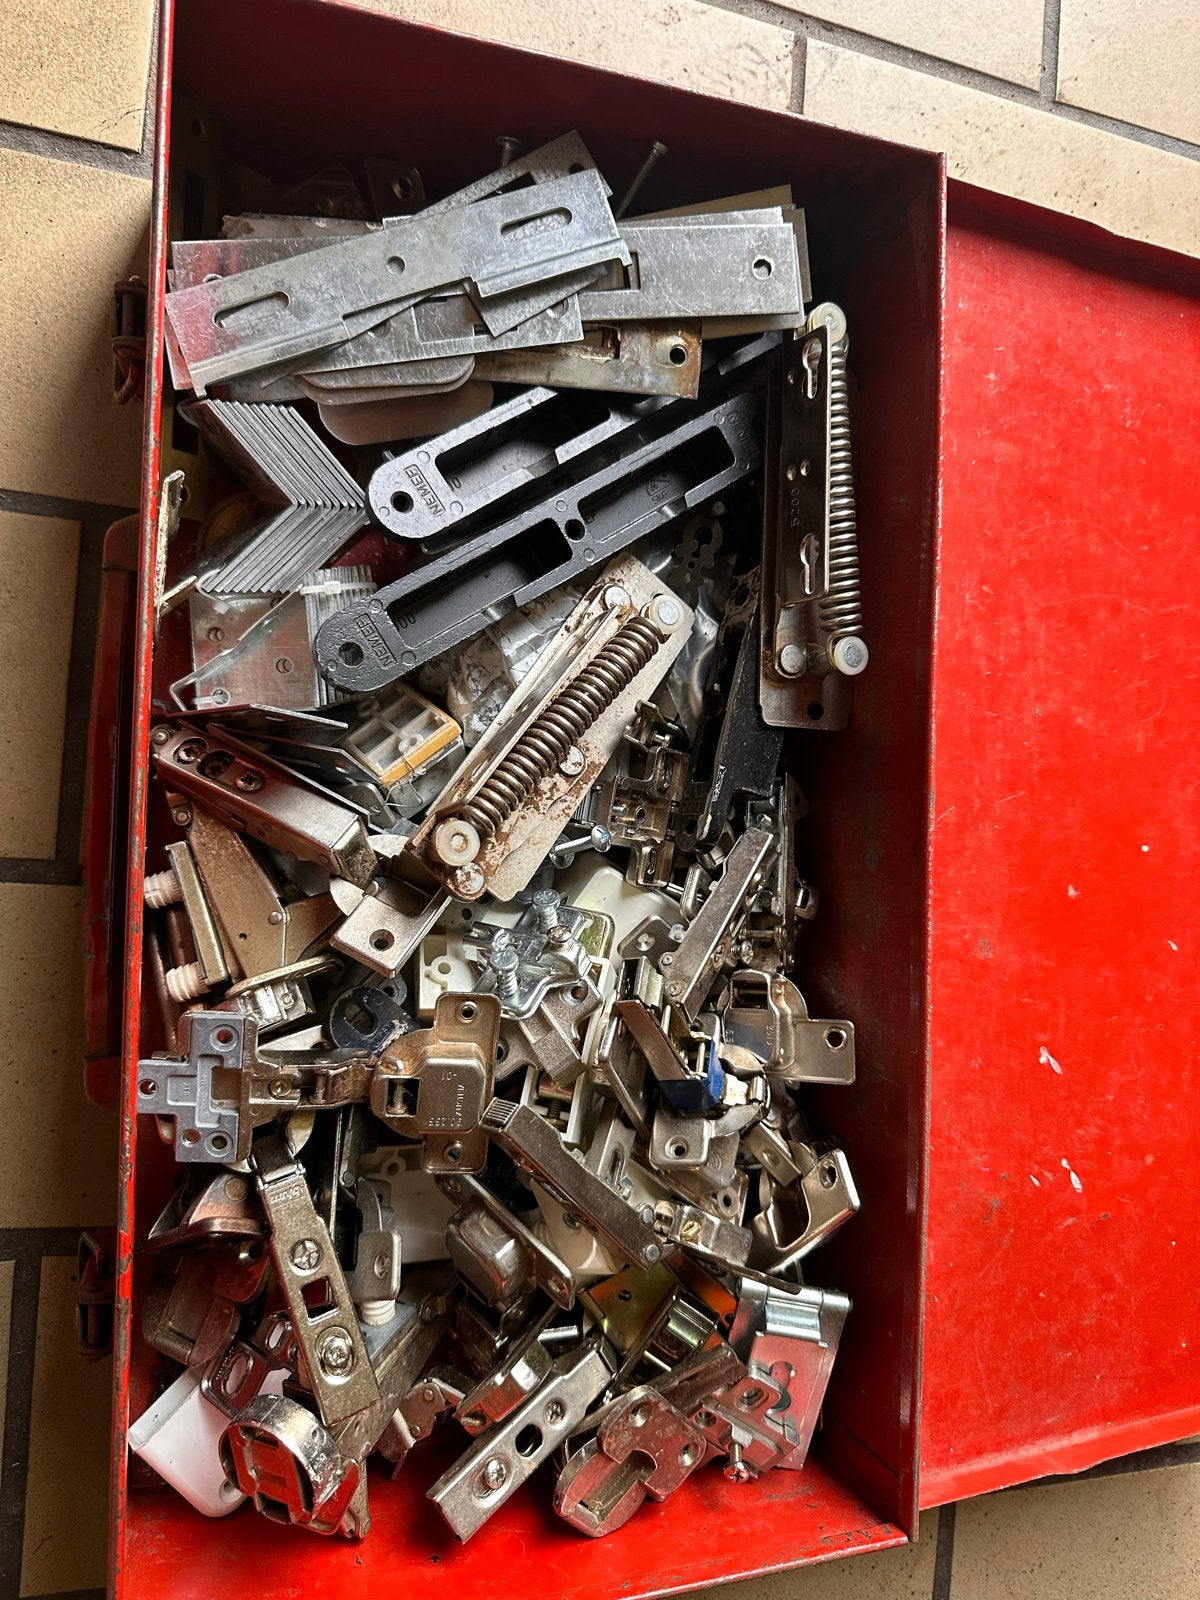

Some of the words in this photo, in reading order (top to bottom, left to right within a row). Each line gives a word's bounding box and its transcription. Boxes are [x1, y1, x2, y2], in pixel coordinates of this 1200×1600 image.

[405, 466, 443, 516] NEMEF
[651, 490, 668, 505] SKG
[355, 617, 395, 667] NEMEF
[455, 1084, 465, 1117] AUSTRIA
